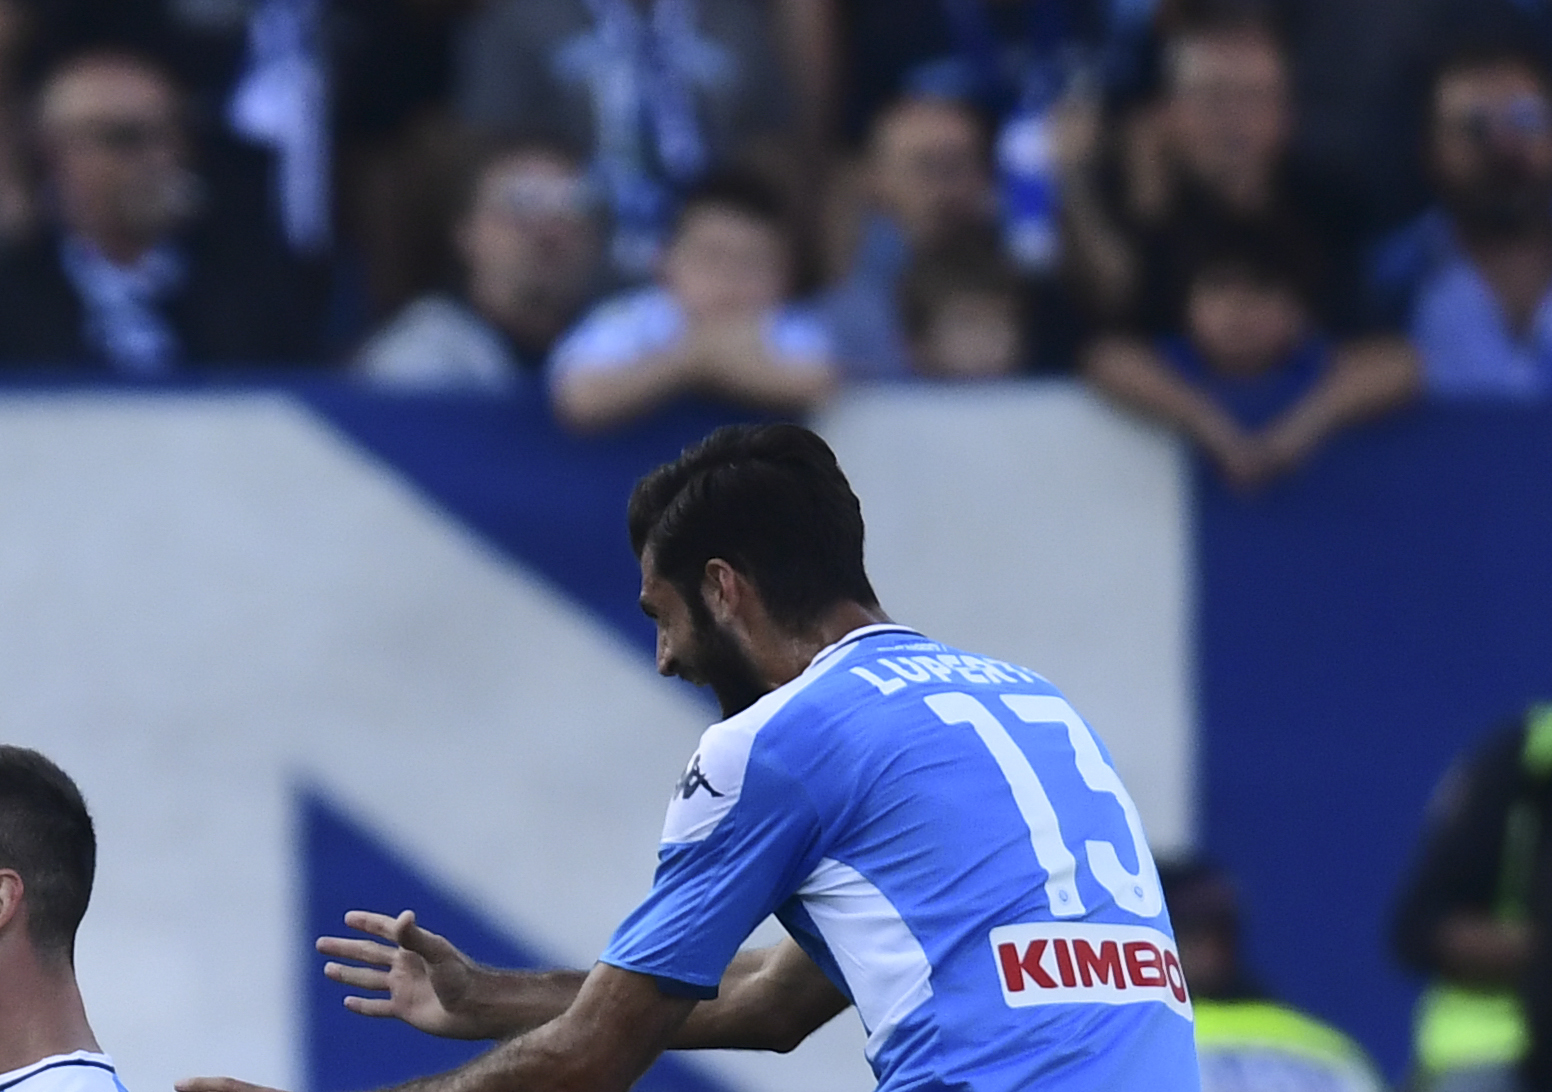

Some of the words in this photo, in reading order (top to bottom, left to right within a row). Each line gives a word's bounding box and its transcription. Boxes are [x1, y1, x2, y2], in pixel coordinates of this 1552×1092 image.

[849, 654, 1052, 696] LUPERT
[923, 691, 1163, 918] 13
[997, 938, 1187, 1004] KIMBO
